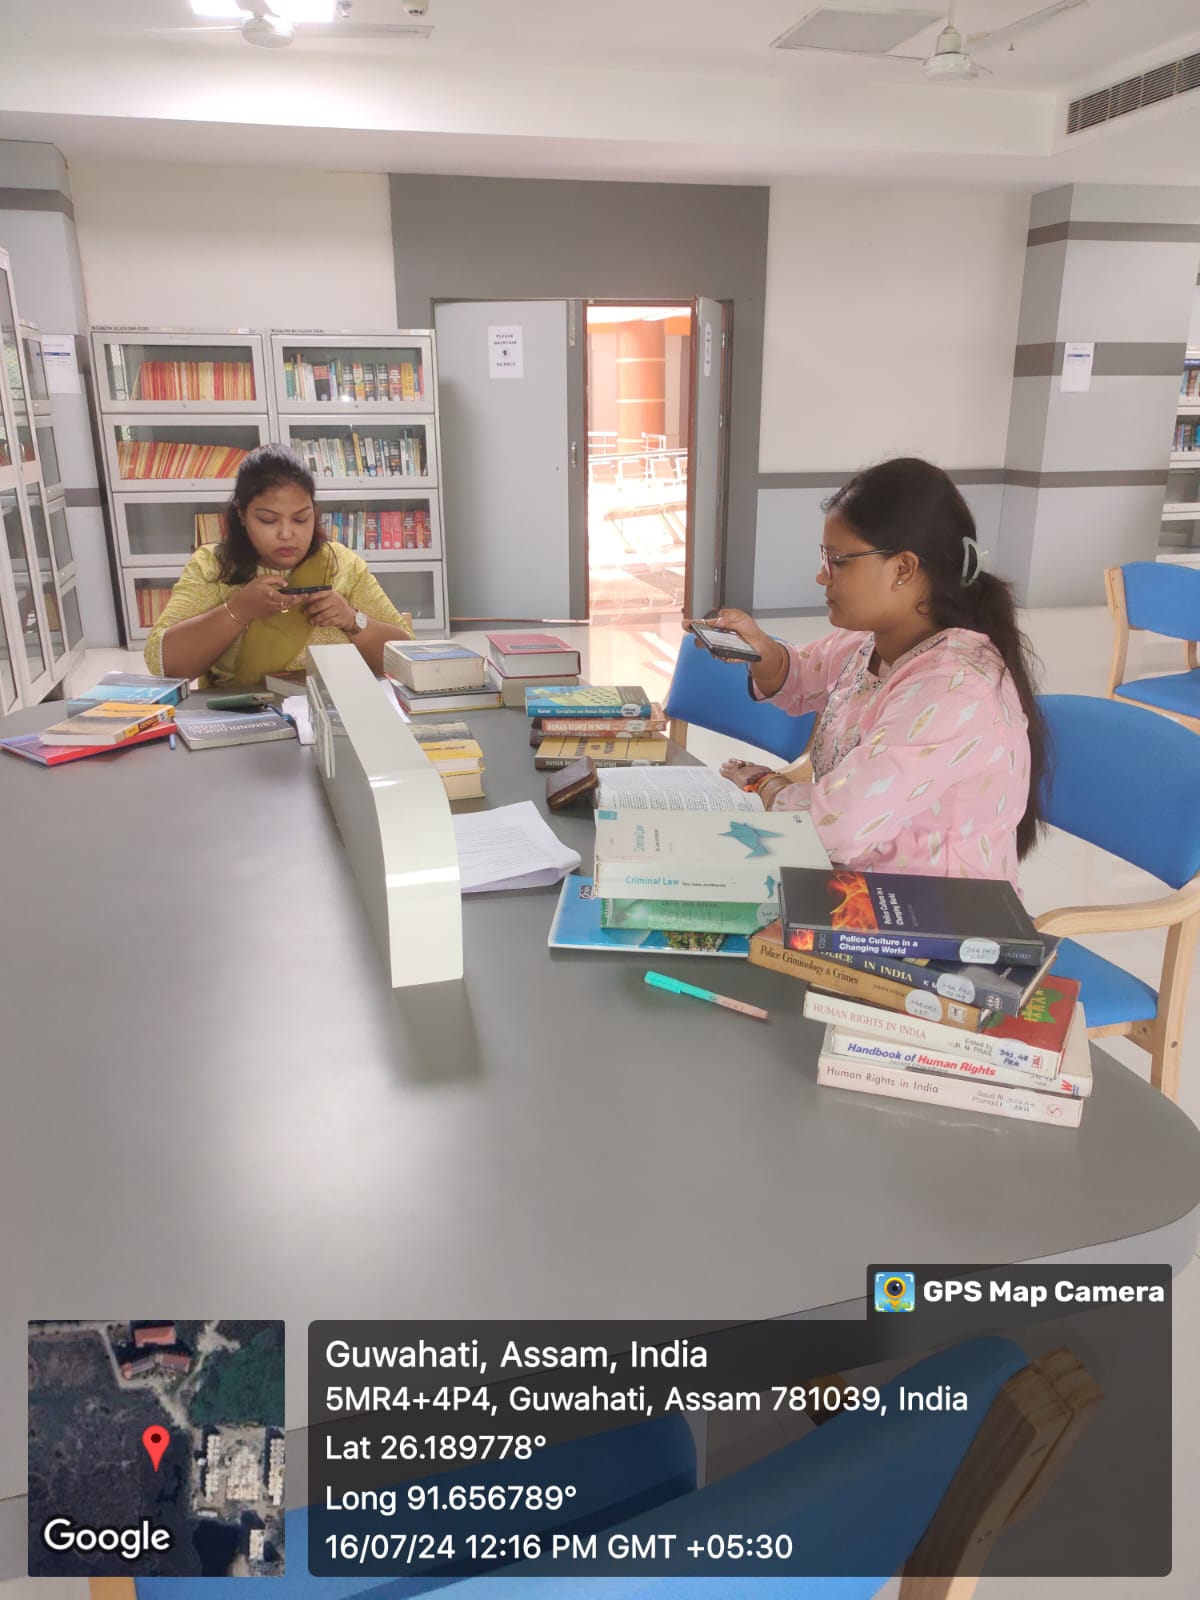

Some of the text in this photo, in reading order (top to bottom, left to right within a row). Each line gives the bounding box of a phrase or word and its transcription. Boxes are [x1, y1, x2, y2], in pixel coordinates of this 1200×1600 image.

[625, 875, 680, 886] Criminal Law
[878, 895, 890, 911] Culture
[882, 910, 893, 925] Police
[839, 934, 866, 944] Police
[868, 936, 900, 946] Culture
[902, 938, 911, 947] in
[839, 943, 907, 955] Changing World
[760, 945, 781, 960] Police
[782, 951, 824, 976] Criminology
[832, 967, 859, 985] Crimes
[818, 950, 913, 982] LICE IN INDIA
[813, 1003, 927, 1040] HUMAN RIGHTS IN INDIA
[847, 1042, 902, 1060] Handbook
[904, 1053, 917, 1062] of
[917, 1055, 958, 1070] Human
[959, 1061, 997, 1077] Rights
[826, 1065, 939, 1094] Human Rights in India
